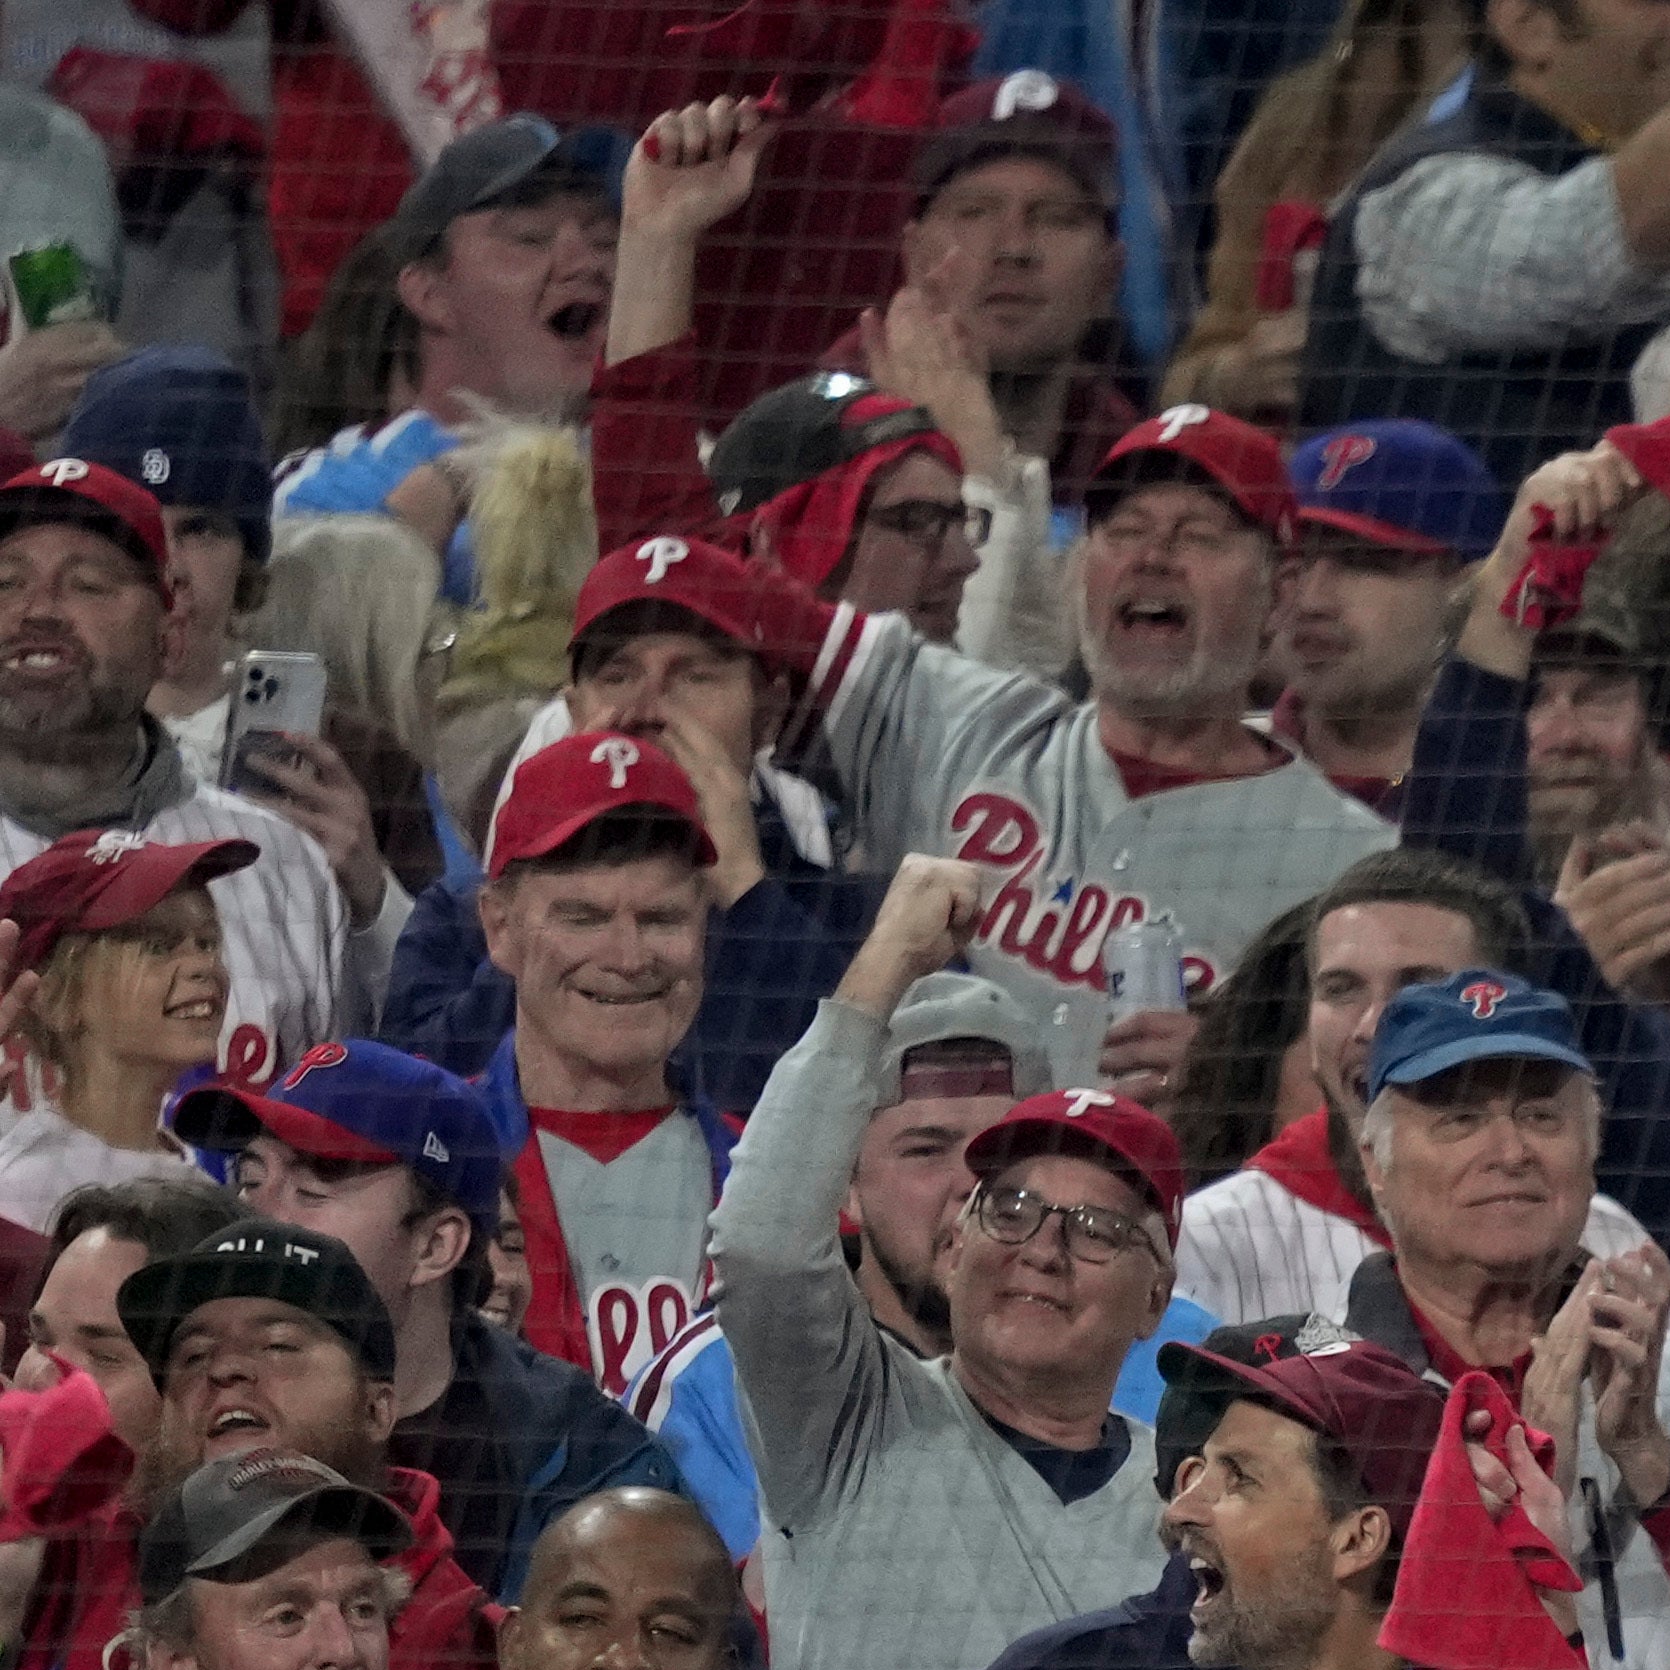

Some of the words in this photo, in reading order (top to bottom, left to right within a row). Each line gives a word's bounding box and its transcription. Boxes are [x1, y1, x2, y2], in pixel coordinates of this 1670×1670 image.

[41, 459, 89, 486] P
[637, 537, 689, 584] P
[591, 737, 640, 789] P
[284, 1043, 348, 1091] P
